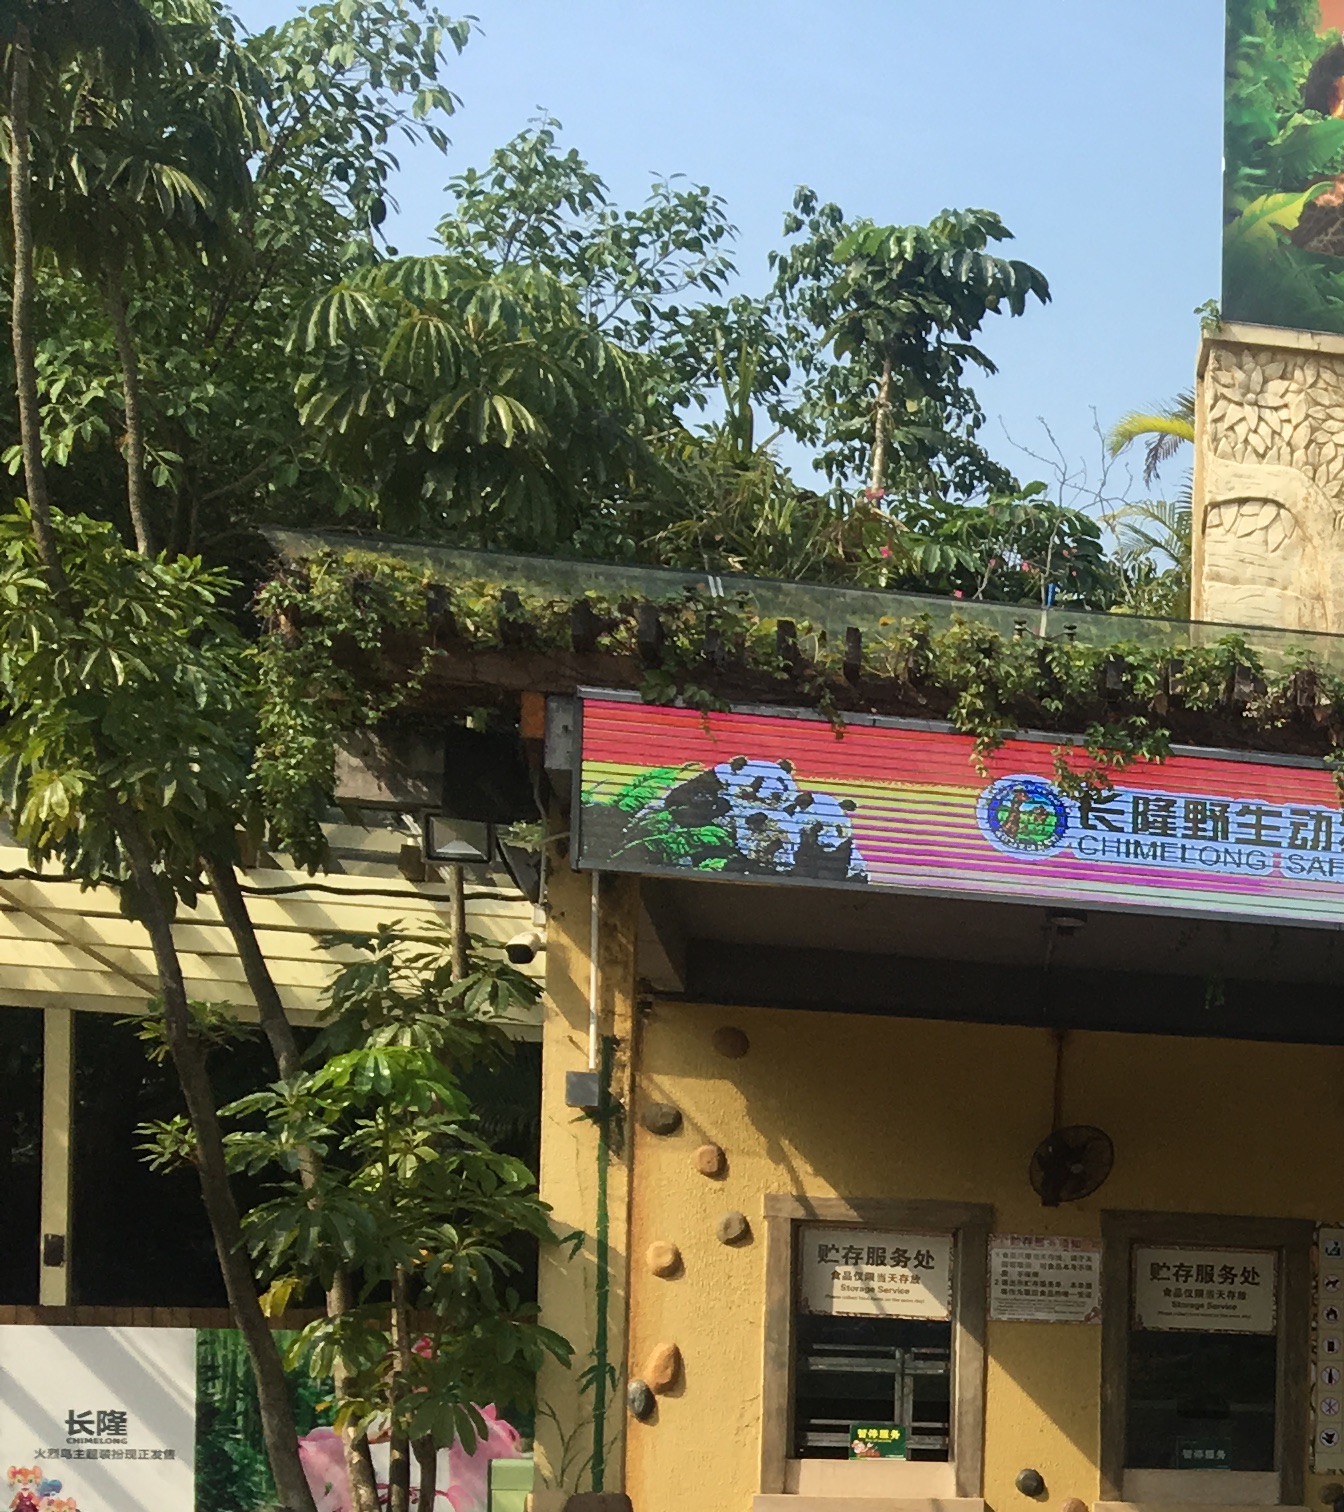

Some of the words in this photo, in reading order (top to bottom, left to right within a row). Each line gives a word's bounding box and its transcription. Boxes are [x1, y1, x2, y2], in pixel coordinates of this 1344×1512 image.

[1077, 834, 1266, 870] CHIMELONG
[817, 1243, 936, 1270] 贮存服务处
[1149, 1262, 1261, 1286] 贮存服务处
[840, 1283, 876, 1295] Storage
[877, 1285, 911, 1296] Service
[64, 1409, 128, 1436] 长隆
[65, 1437, 128, 1445] CHIMELONG
